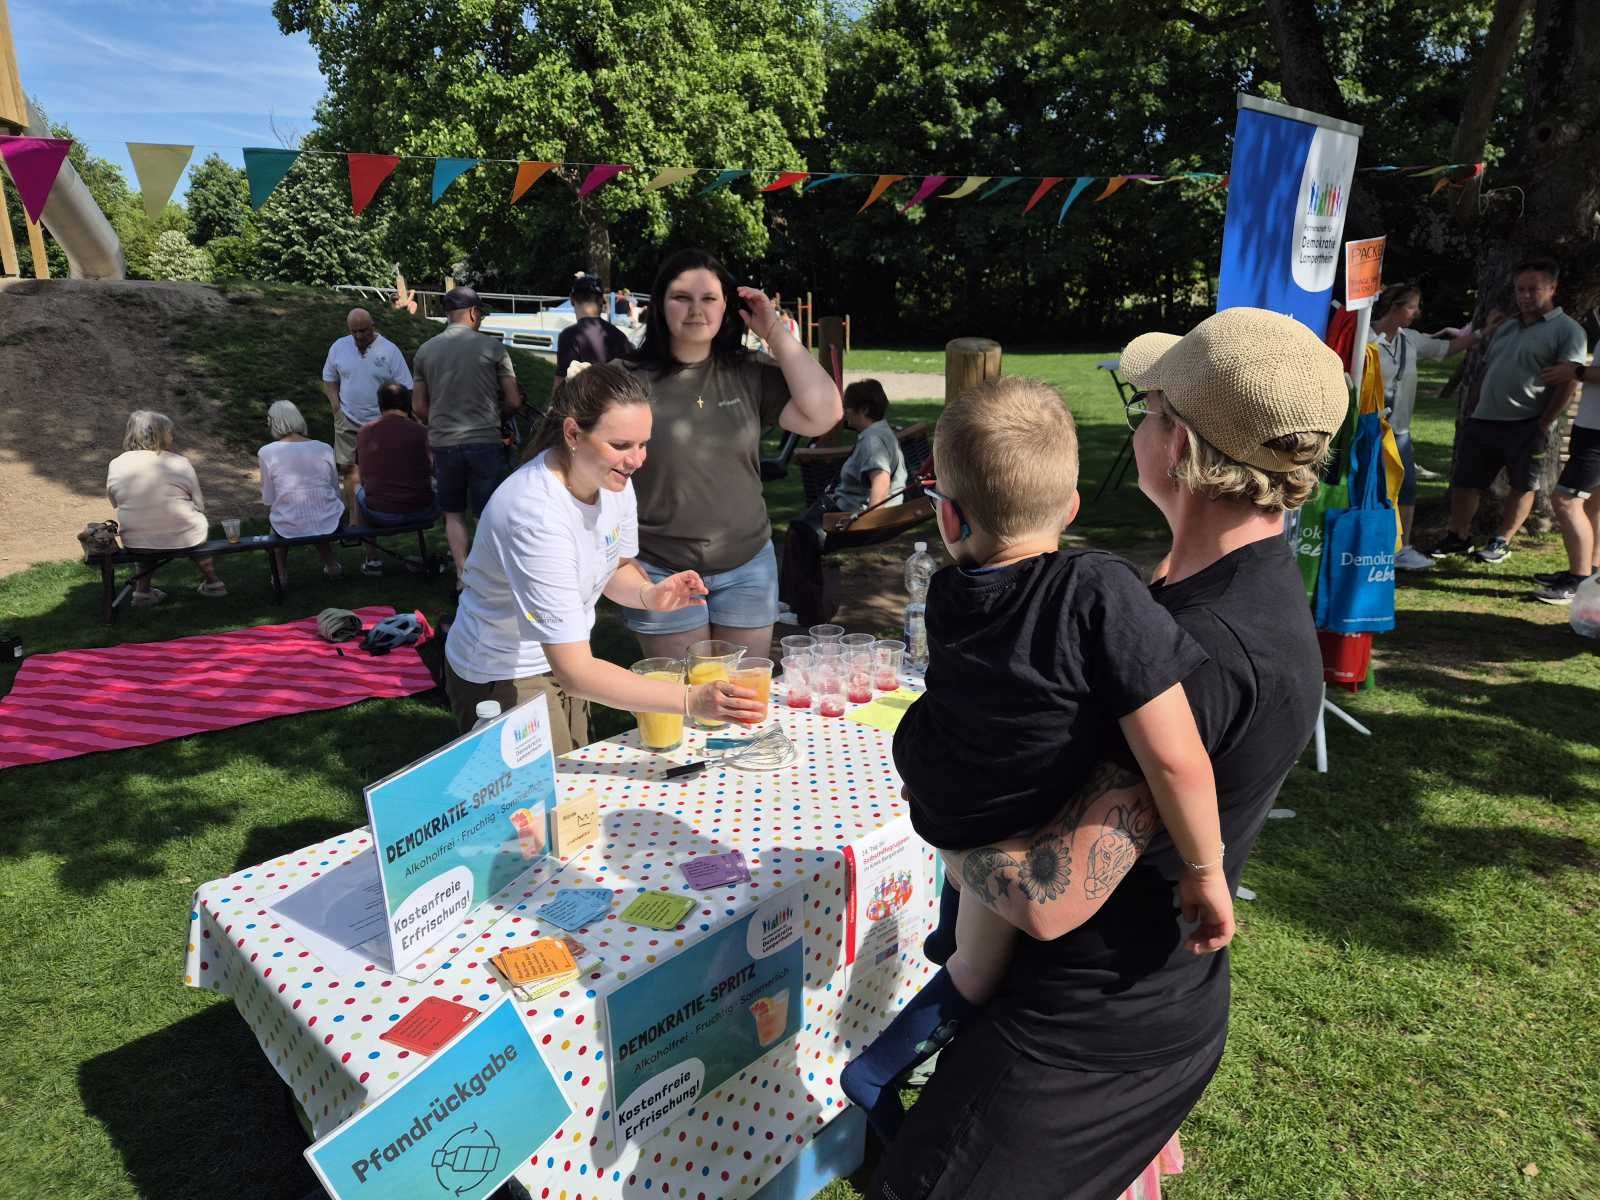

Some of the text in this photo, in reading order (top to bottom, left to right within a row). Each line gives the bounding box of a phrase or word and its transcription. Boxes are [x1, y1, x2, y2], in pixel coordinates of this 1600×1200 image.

[1301, 236, 1336, 249] Demokratie
[386, 771, 512, 865] DEMOKRATIE-SPRITZ
[404, 839, 456, 878] Alkoholfrei
[461, 812, 497, 841] Fruchtig
[394, 879, 462, 934] Kostenfreie
[401, 890, 471, 951] Erfrischung!
[618, 962, 757, 1062] DEMOKRATIE-SPRITZ
[634, 1034, 689, 1075] Alkoholfrei
[695, 1005, 734, 1034] Fruchtig
[351, 1043, 520, 1184] Pfandrückgabe
[618, 1071, 691, 1126] Kostenfreie
[625, 1079, 701, 1141] Erfrischung!
